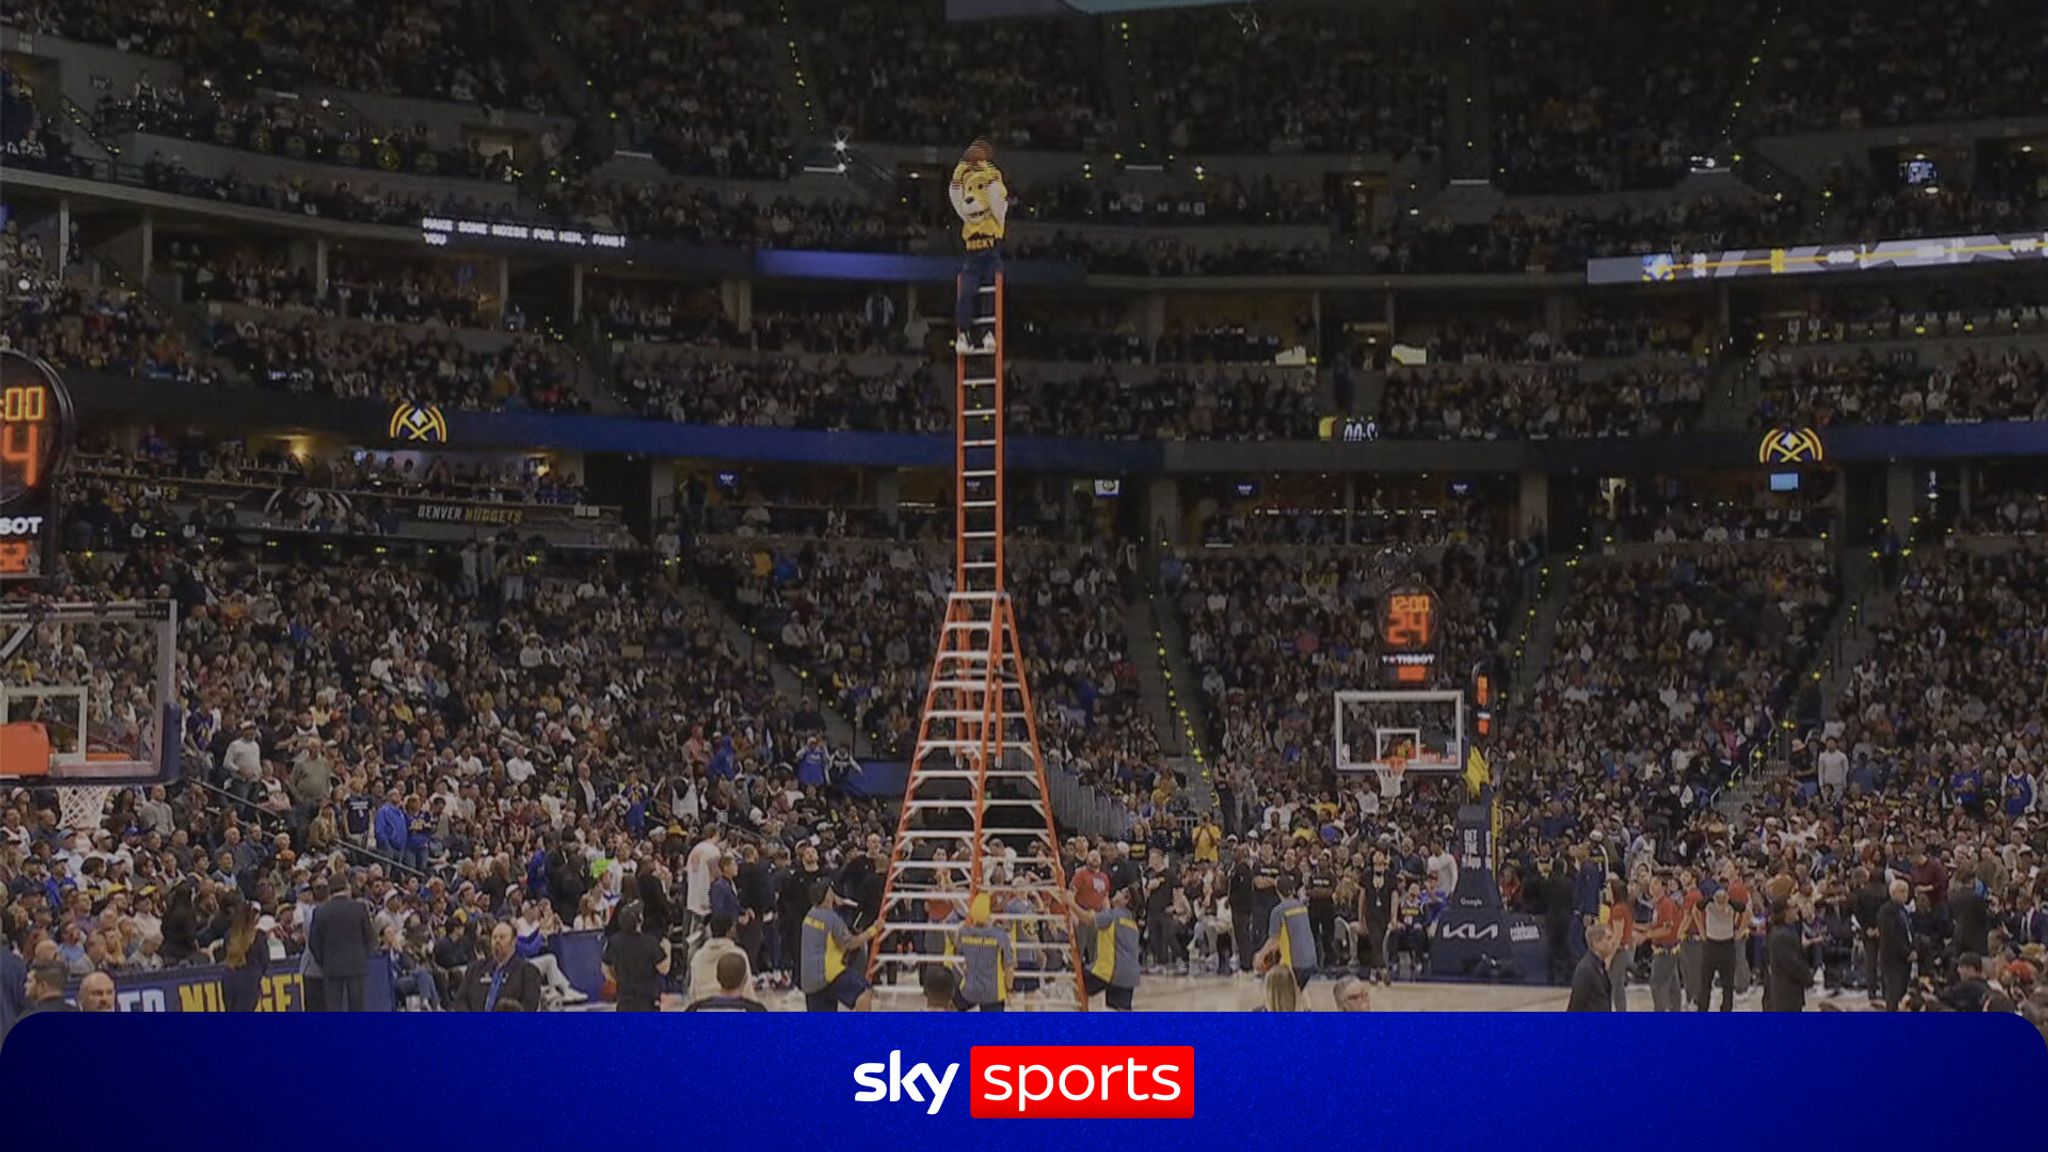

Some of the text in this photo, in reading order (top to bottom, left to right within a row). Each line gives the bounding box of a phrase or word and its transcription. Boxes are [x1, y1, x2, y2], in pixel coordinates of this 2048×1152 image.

[423, 232, 447, 246] YOU
[458, 220, 488, 235] SOME
[492, 223, 528, 239] NOISE
[533, 227, 555, 242] FOR
[418, 504, 523, 524] DENVER NUGGETS
[1388, 612, 1428, 645] 24
[1459, 896, 1483, 908] Google
